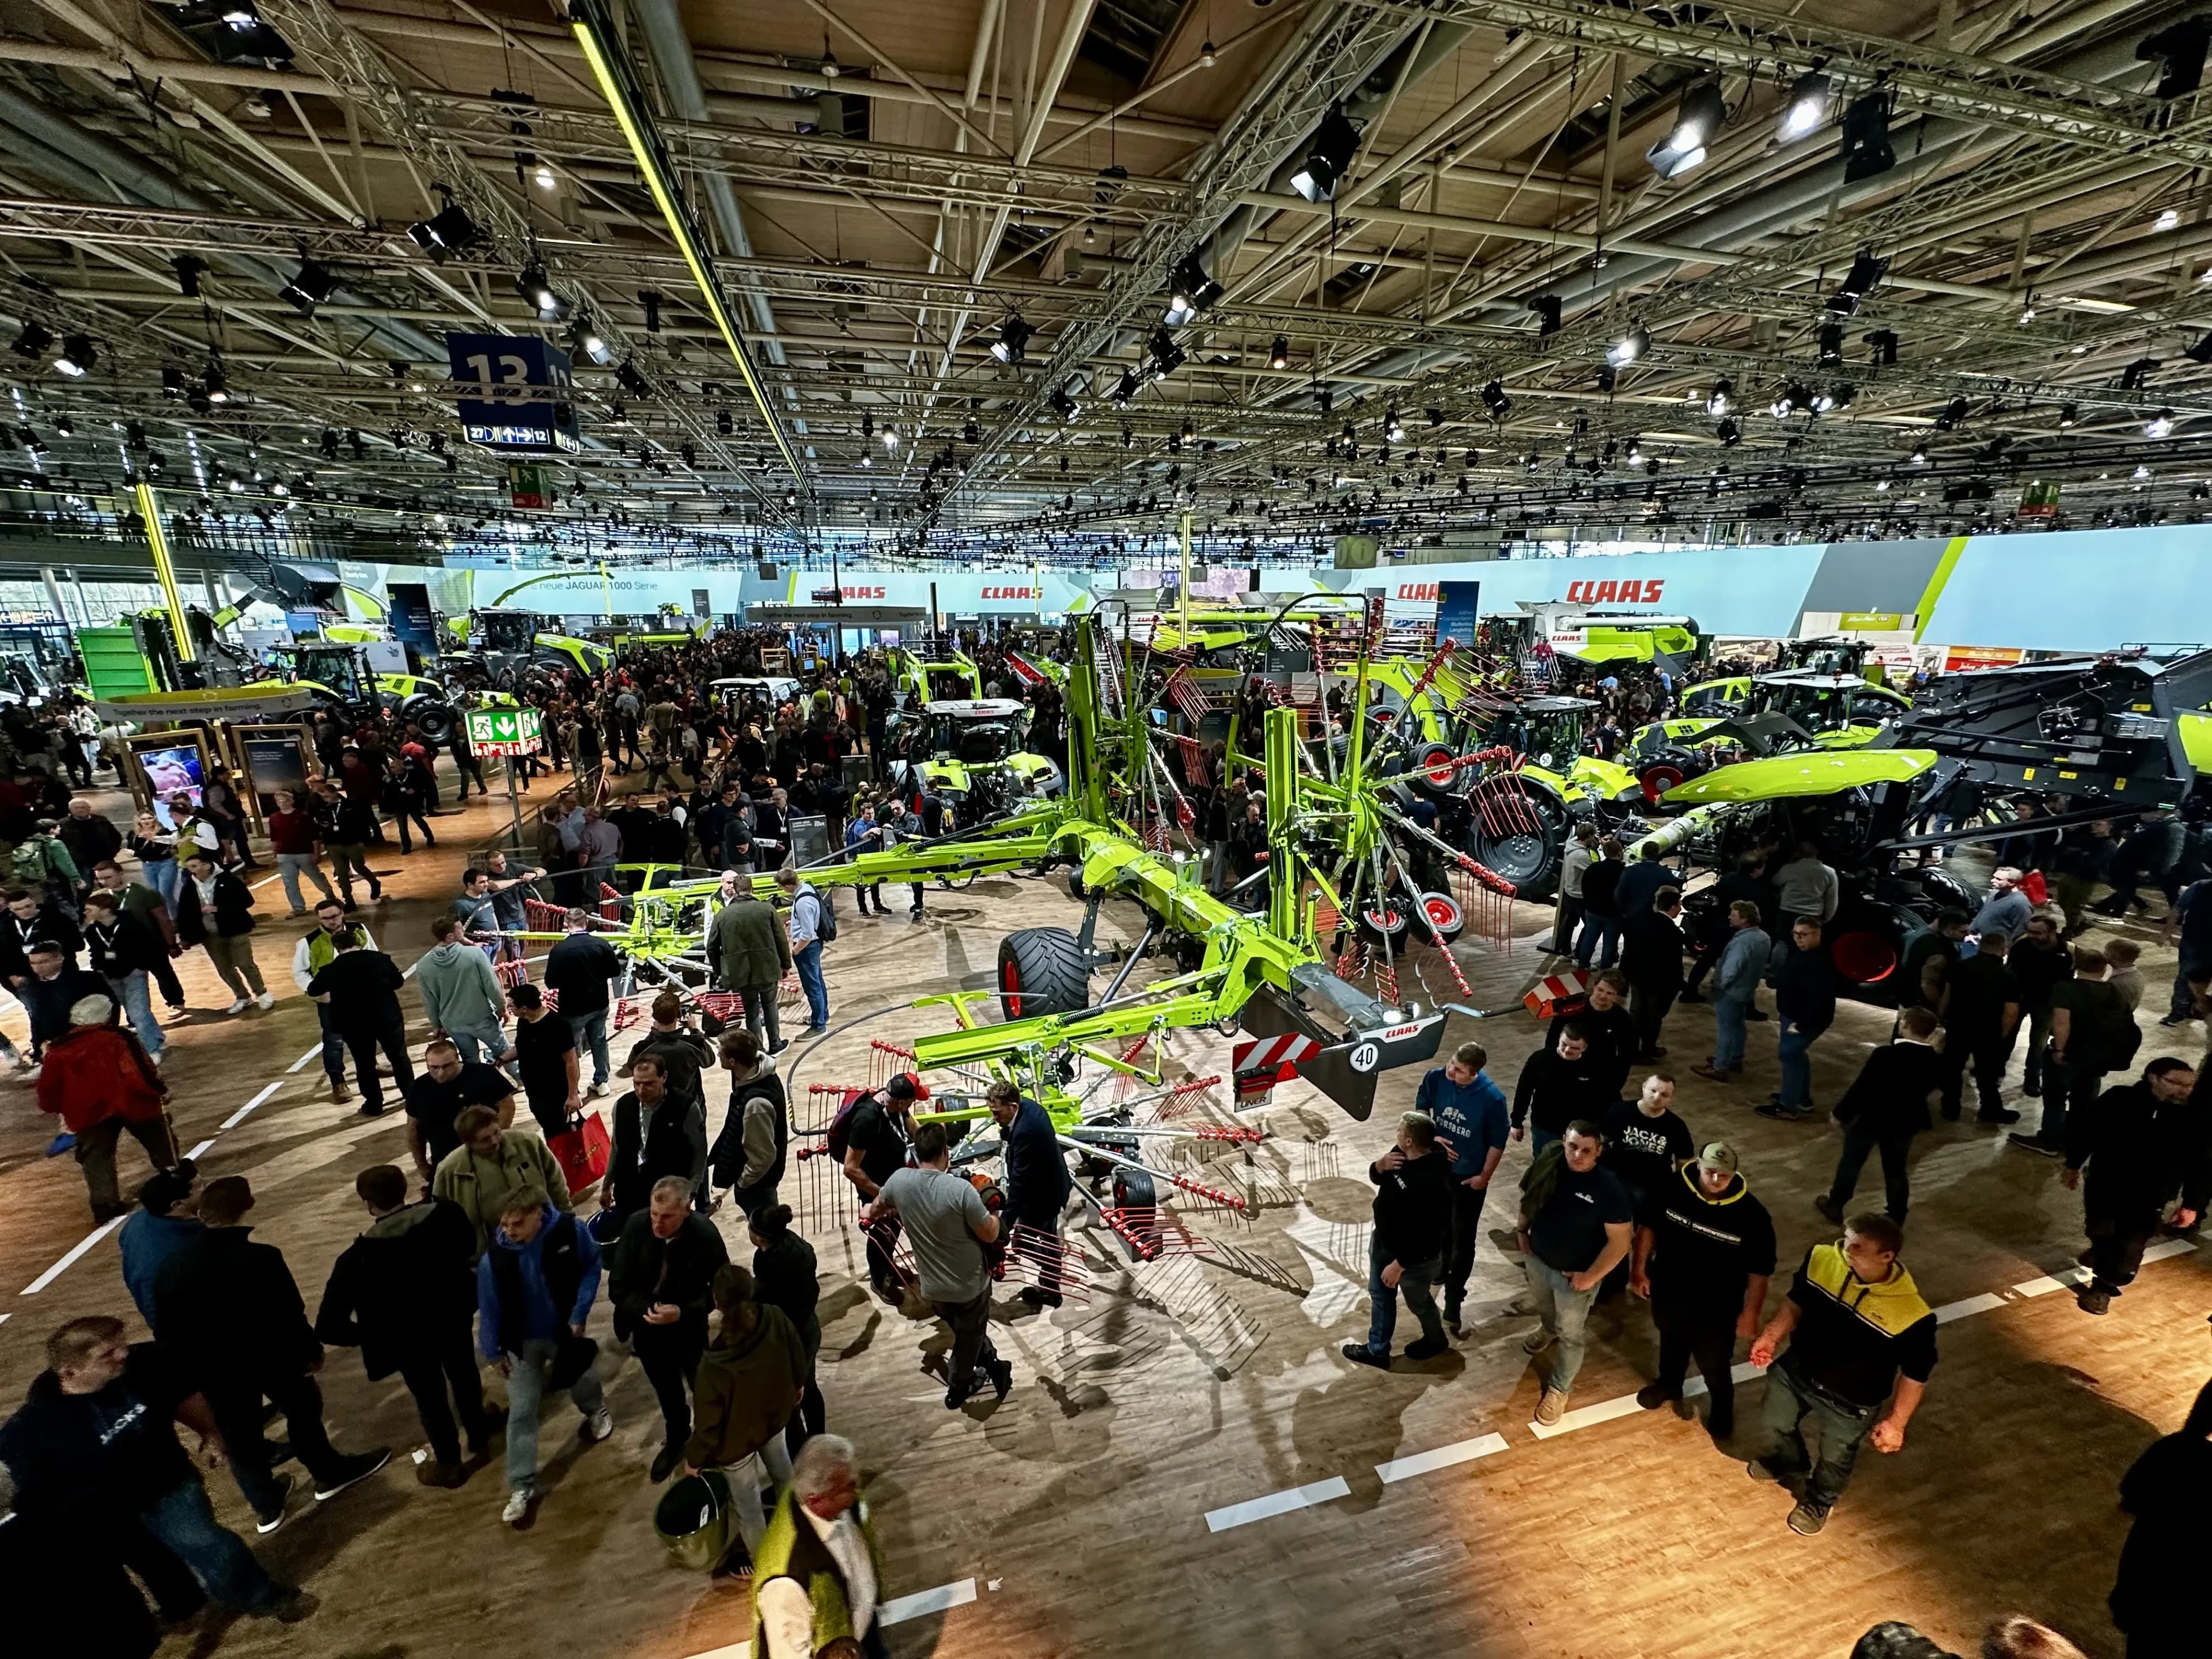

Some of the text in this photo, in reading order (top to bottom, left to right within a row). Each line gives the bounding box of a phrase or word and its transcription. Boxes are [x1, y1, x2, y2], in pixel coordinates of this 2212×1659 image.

[467, 354, 532, 406] 13
[470, 427, 484, 438] 27
[535, 431, 546, 441] 12
[540, 582, 563, 590] neue
[566, 581, 605, 590] JAGUAR
[609, 581, 632, 590] 1000
[634, 581, 658, 590] Serie
[1397, 584, 1440, 600] CLAA
[1566, 579, 1665, 604] CLAAS
[820, 586, 886, 599] AAS
[981, 587, 1043, 599] CLAAS
[113, 709, 146, 717] Together
[1542, 756, 1550, 764] 50
[1385, 1025, 1419, 1038] CLAAS
[1355, 1047, 1373, 1066] 40
[1240, 1097, 1266, 1108] LINER
[1437, 1116, 1471, 1138] FORSBERG
[1623, 1126, 1667, 1147] JACK&
[1622, 1135, 1664, 1155] JONES
